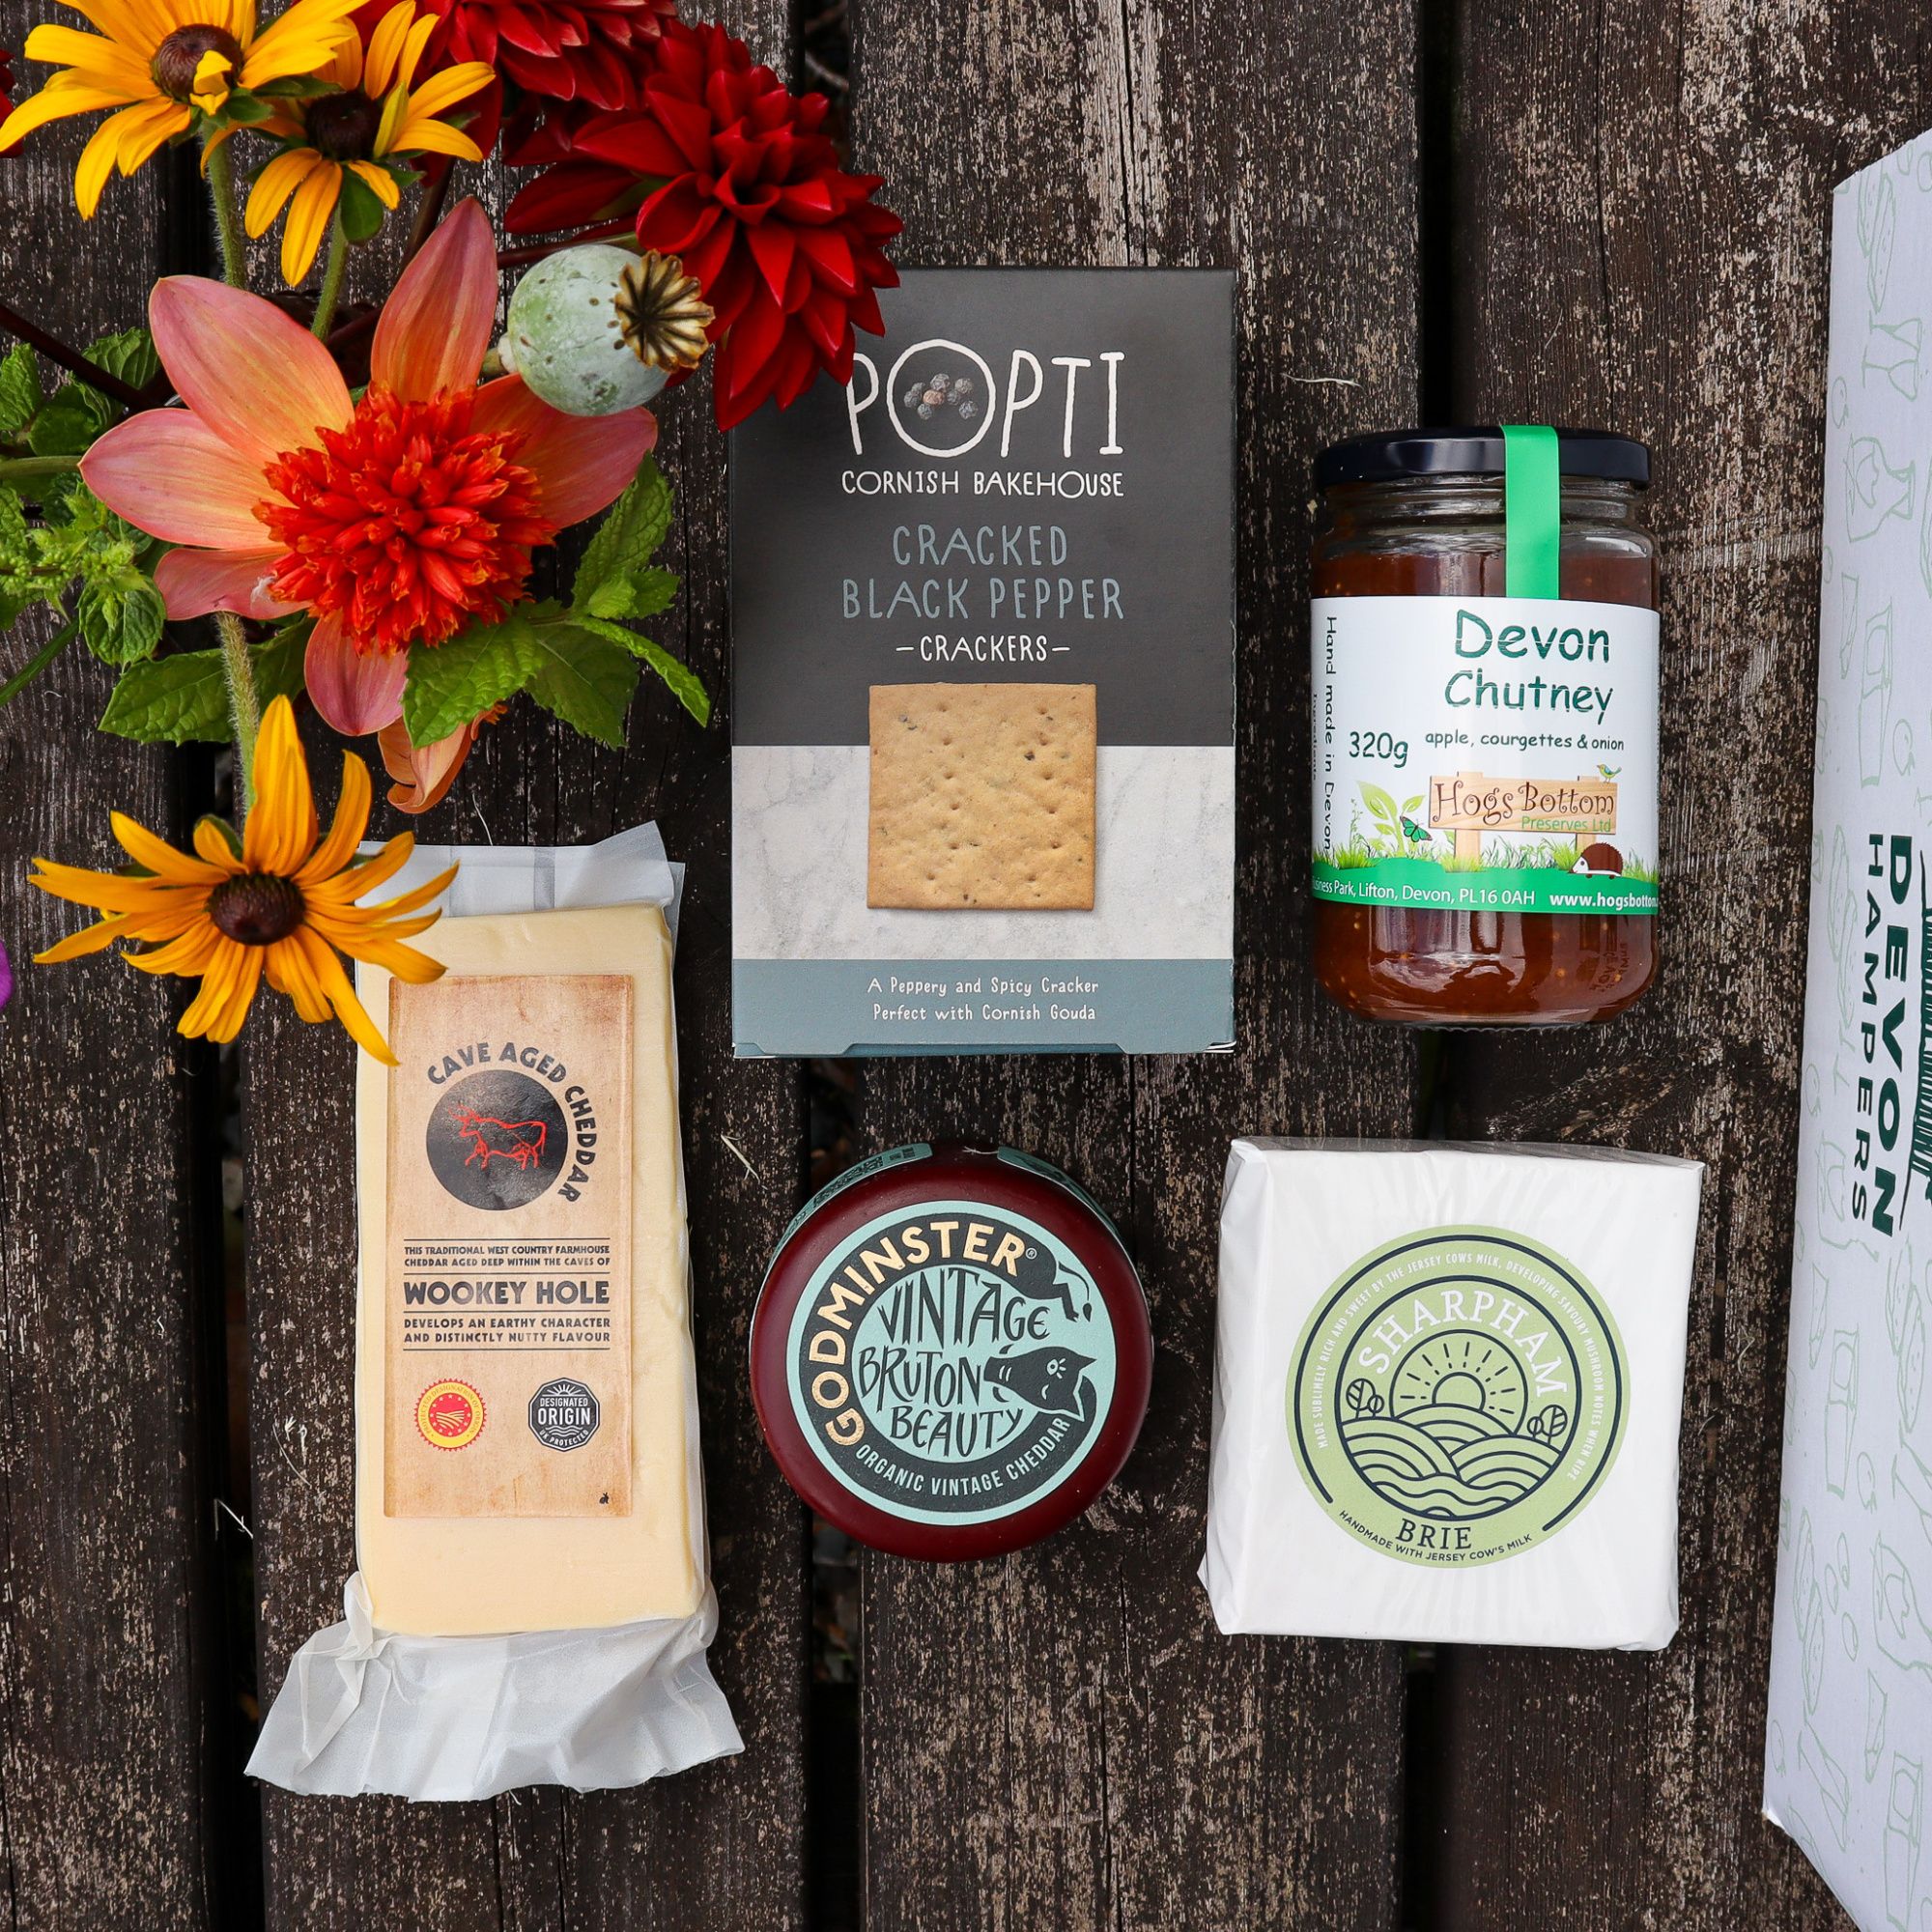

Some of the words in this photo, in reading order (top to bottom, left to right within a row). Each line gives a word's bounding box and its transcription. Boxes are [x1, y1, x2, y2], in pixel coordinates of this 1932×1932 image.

[846, 338, 1124, 458] POPTI
[841, 470, 959, 495] CORNISH
[974, 470, 1124, 498] BAKEHOUSE
[892, 525, 1067, 566] CRACKED
[842, 578, 969, 619] BLACK
[990, 578, 1124, 619] PEPPER
[1325, 616, 1337, 675] Hand
[1455, 609, 1610, 663] Devon
[1444, 668, 1614, 725] Chutney
[1324, 684, 1336, 745] made
[1349, 731, 1408, 769] 320g
[1425, 729, 1475, 747] apple,
[1480, 732, 1572, 752] courgettes
[1577, 734, 1588, 750] &
[1591, 735, 1625, 752] onion
[1324, 753, 1335, 772] in
[1323, 781, 1335, 849] Devon
[1431, 780, 1514, 826] Hogs
[1518, 781, 1615, 816] Bottom
[1520, 816, 1589, 832] Preserves
[1592, 818, 1611, 834] Ltd
[1334, 879, 1356, 897] Park,
[1358, 882, 1398, 901] Lifton,
[1402, 884, 1455, 904] Devon,
[1459, 889, 1497, 904] PL16
[867, 978, 882, 993] A
[891, 977, 947, 997] Peppery
[955, 977, 982, 993] and
[990, 977, 1033, 997] Spicy
[1041, 977, 1099, 993] Cracker
[873, 1004, 926, 1020] Perfect
[934, 1004, 972, 1020] with
[981, 1004, 1040, 1020] Cornish
[1050, 1004, 1096, 1020] Gouda
[1851, 834, 1884, 1221] HAMPERS
[1871, 835, 1913, 1237] DEVON
[427, 1042, 491, 1085] CAVE
[498, 1042, 567, 1083] AGED
[557, 1086, 598, 1203] CHEDDAR
[404, 1258, 448, 1266] CHEDDAR
[451, 1258, 478, 1266] AGED
[481, 1258, 504, 1266] DEEP
[507, 1258, 541, 1266] WITHIN
[544, 1258, 562, 1266] THE
[564, 1258, 594, 1266] CAVES
[405, 1246, 423, 1255] THIS
[425, 1246, 485, 1255] TRADITIONAL
[487, 1246, 509, 1255] WEST
[512, 1246, 554, 1255] COUNTRY
[555, 1245, 611, 1254] FARMHOUSE
[1406, 1255, 1442, 1274] JERSEY
[1445, 1253, 1473, 1264] COWS
[1373, 1280, 1384, 1293] BY
[1386, 1267, 1405, 1286] THE
[1506, 1260, 1561, 1298] DEVELOPING
[404, 1281, 527, 1305] WOOKEY
[536, 1280, 611, 1304] HOLE
[877, 1267, 1051, 1348] VINTAGE
[1346, 1290, 1373, 1318] SWEET
[404, 1319, 464, 1328] DEVELOPS
[468, 1319, 486, 1328] AN
[490, 1319, 536, 1328] EARTHY
[541, 1318, 611, 1327] CHARACTER
[1331, 1318, 1348, 1337] AND
[1559, 1295, 1590, 1336] SAVOURY
[404, 1333, 430, 1343] AND
[435, 1333, 504, 1343] DISTINCTLY
[509, 1333, 547, 1342] NUTTY
[553, 1332, 611, 1342] FLAVOUR
[1321, 1339, 1333, 1364] RICH
[1357, 1289, 1568, 1399] SHARPHAM
[858, 1346, 981, 1412] BRUTON
[1585, 1337, 1604, 1393] MUSHROOM
[540, 1397, 588, 1406] DESIGNATED
[1315, 1365, 1326, 1422] SUBLIMELY
[538, 1407, 590, 1425] ORIGIN
[1593, 1396, 1605, 1427] NOTES
[539, 1430, 550, 1439] UK
[549, 1430, 589, 1446] PROTECTED
[890, 1406, 1023, 1458] BEAUTY
[1315, 1422, 1328, 1449] MADE
[1583, 1429, 1600, 1462] WHEN
[856, 1444, 923, 1492] ORGANIC
[930, 1475, 1004, 1496] VINTAGE
[1006, 1417, 1071, 1481] CHEDDAR
[1567, 1460, 1587, 1482] RIPE
[1339, 1510, 1392, 1549] HANDMADE
[1395, 1543, 1423, 1559] WITH
[1425, 1552, 1465, 1562] JERSEY
[1469, 1547, 1505, 1560] COW'S
[1506, 1534, 1533, 1549] MILK
[1394, 1518, 1472, 1550] BRIE
